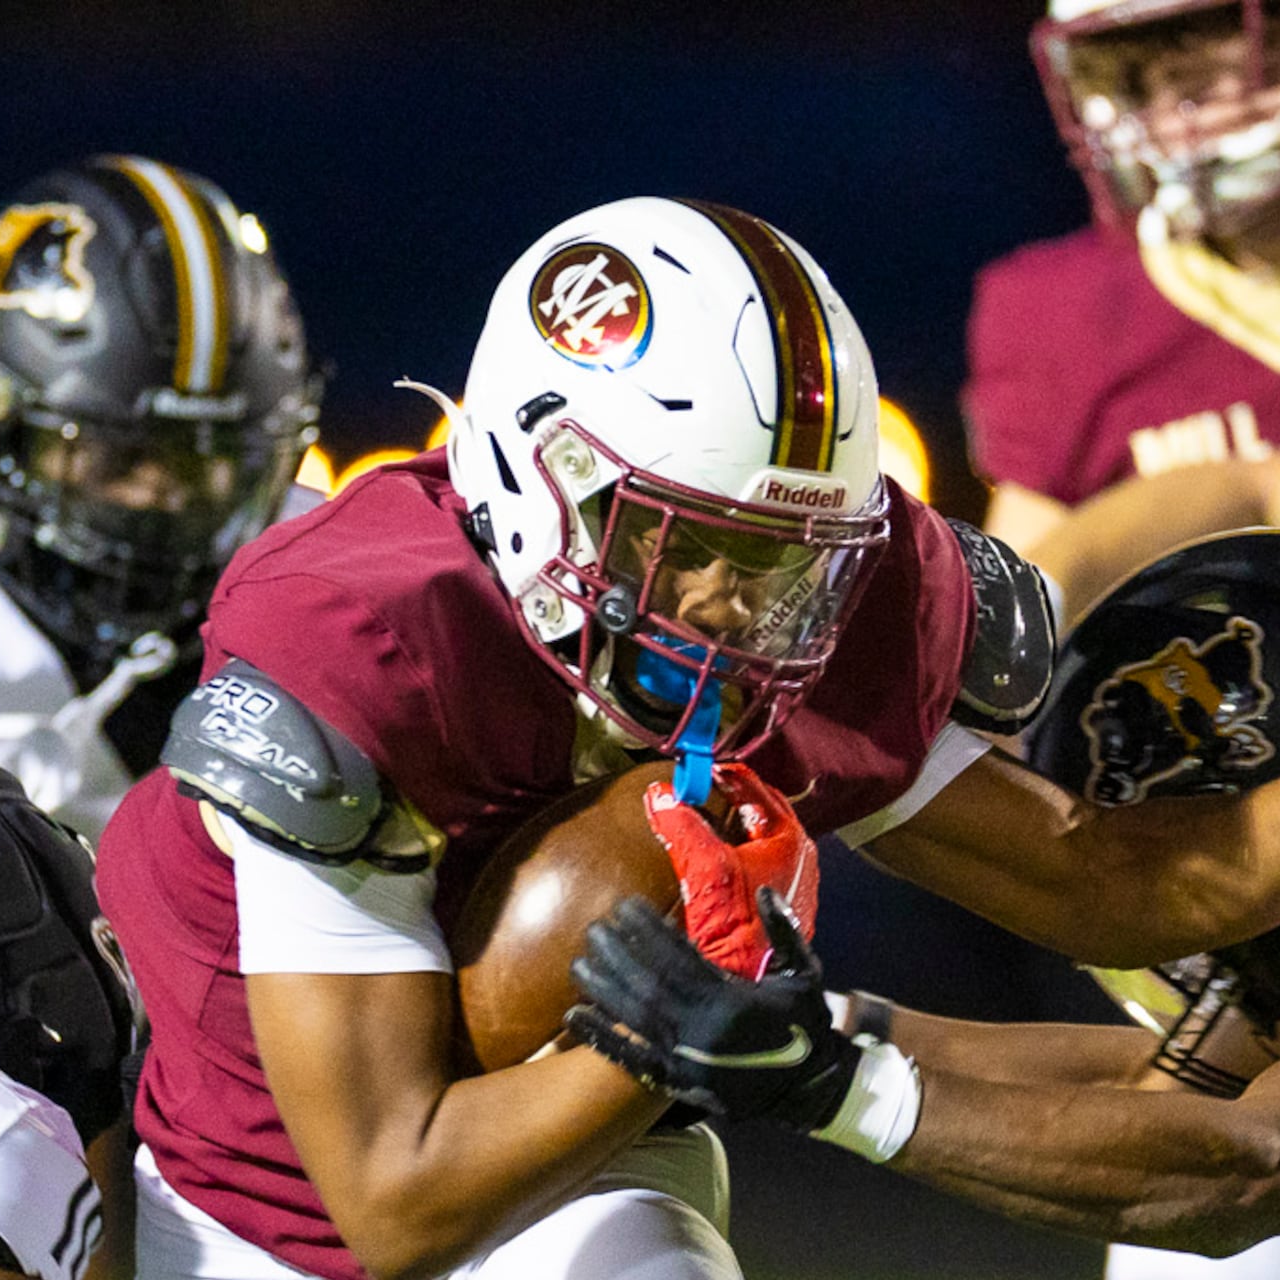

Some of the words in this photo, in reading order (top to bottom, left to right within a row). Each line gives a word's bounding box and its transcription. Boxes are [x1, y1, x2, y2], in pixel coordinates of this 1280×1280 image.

[764, 477, 848, 510] Riddell
[746, 576, 815, 648] Riddell
[192, 675, 280, 725] PRO
